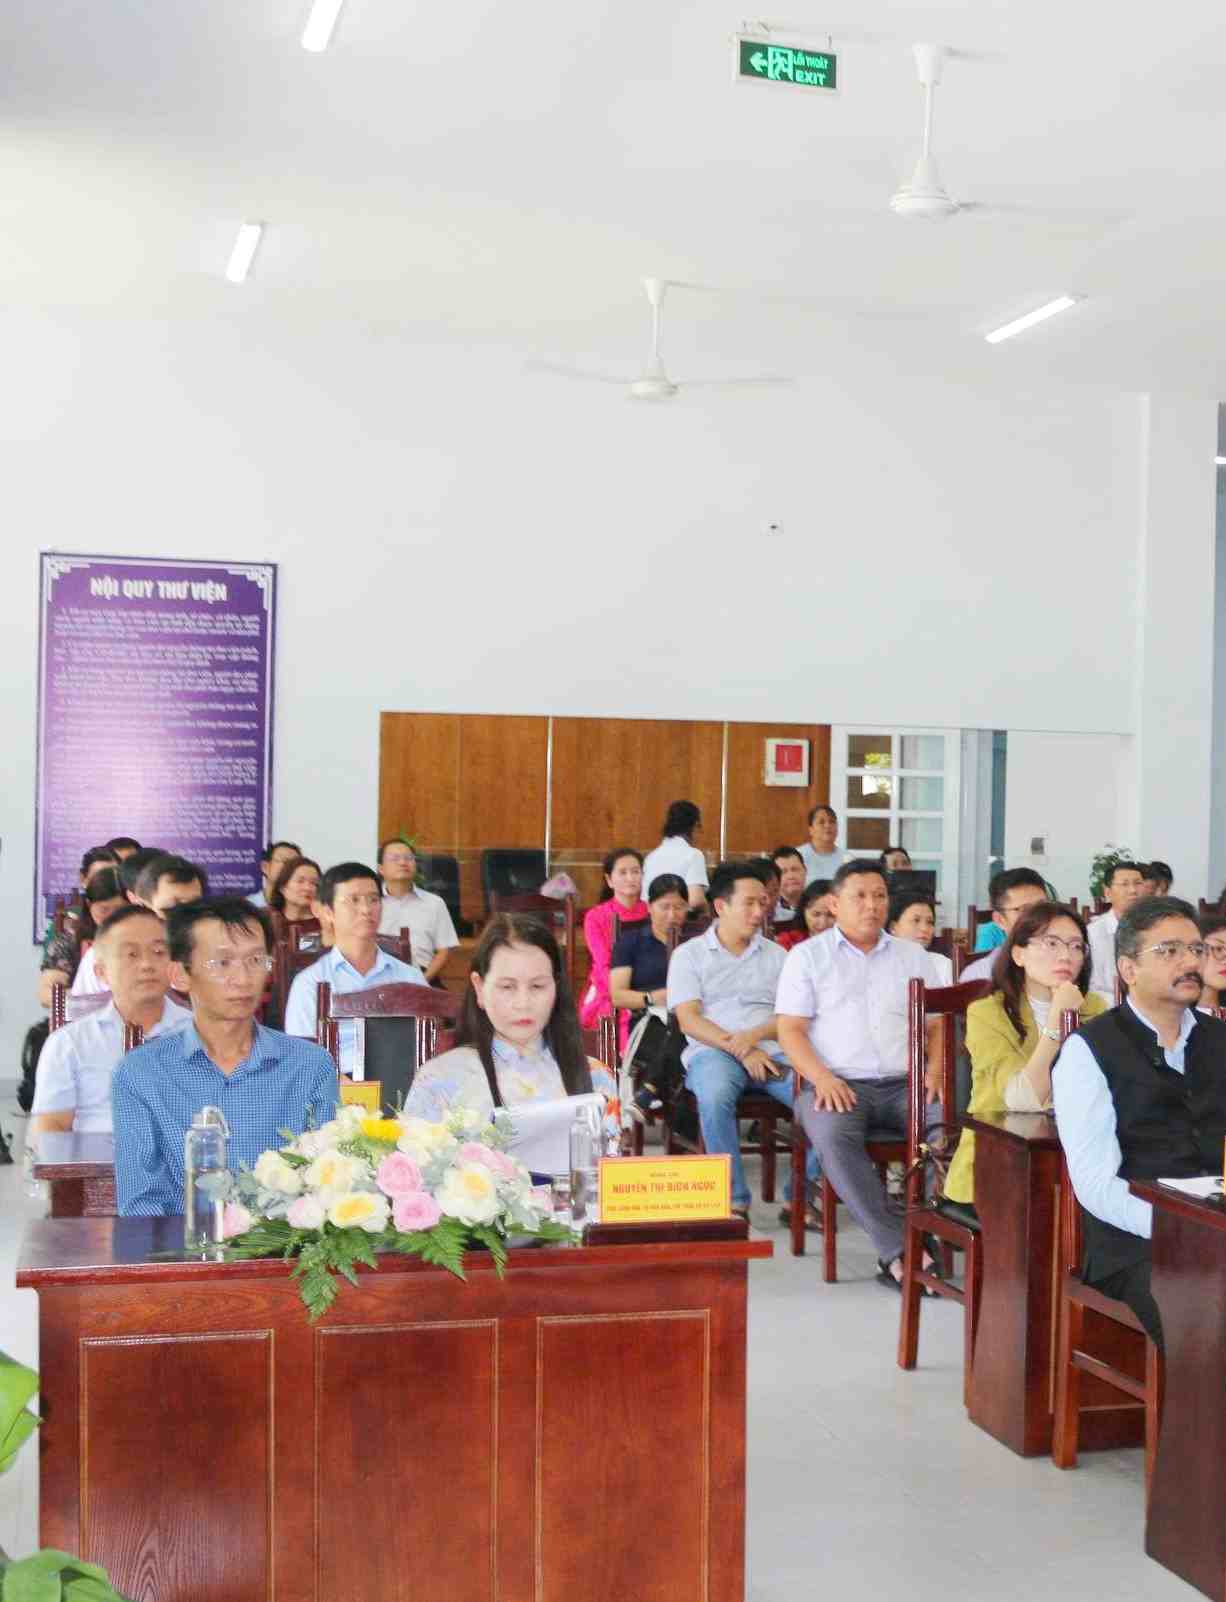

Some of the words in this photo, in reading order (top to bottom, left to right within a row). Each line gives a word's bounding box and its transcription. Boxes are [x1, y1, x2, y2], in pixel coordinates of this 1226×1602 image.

[795, 69, 826, 85] EXIT
[90, 575, 119, 600] NỘI
[122, 579, 155, 599] QUY
[156, 579, 190, 600] THƯ
[191, 579, 227, 605] VIỆN
